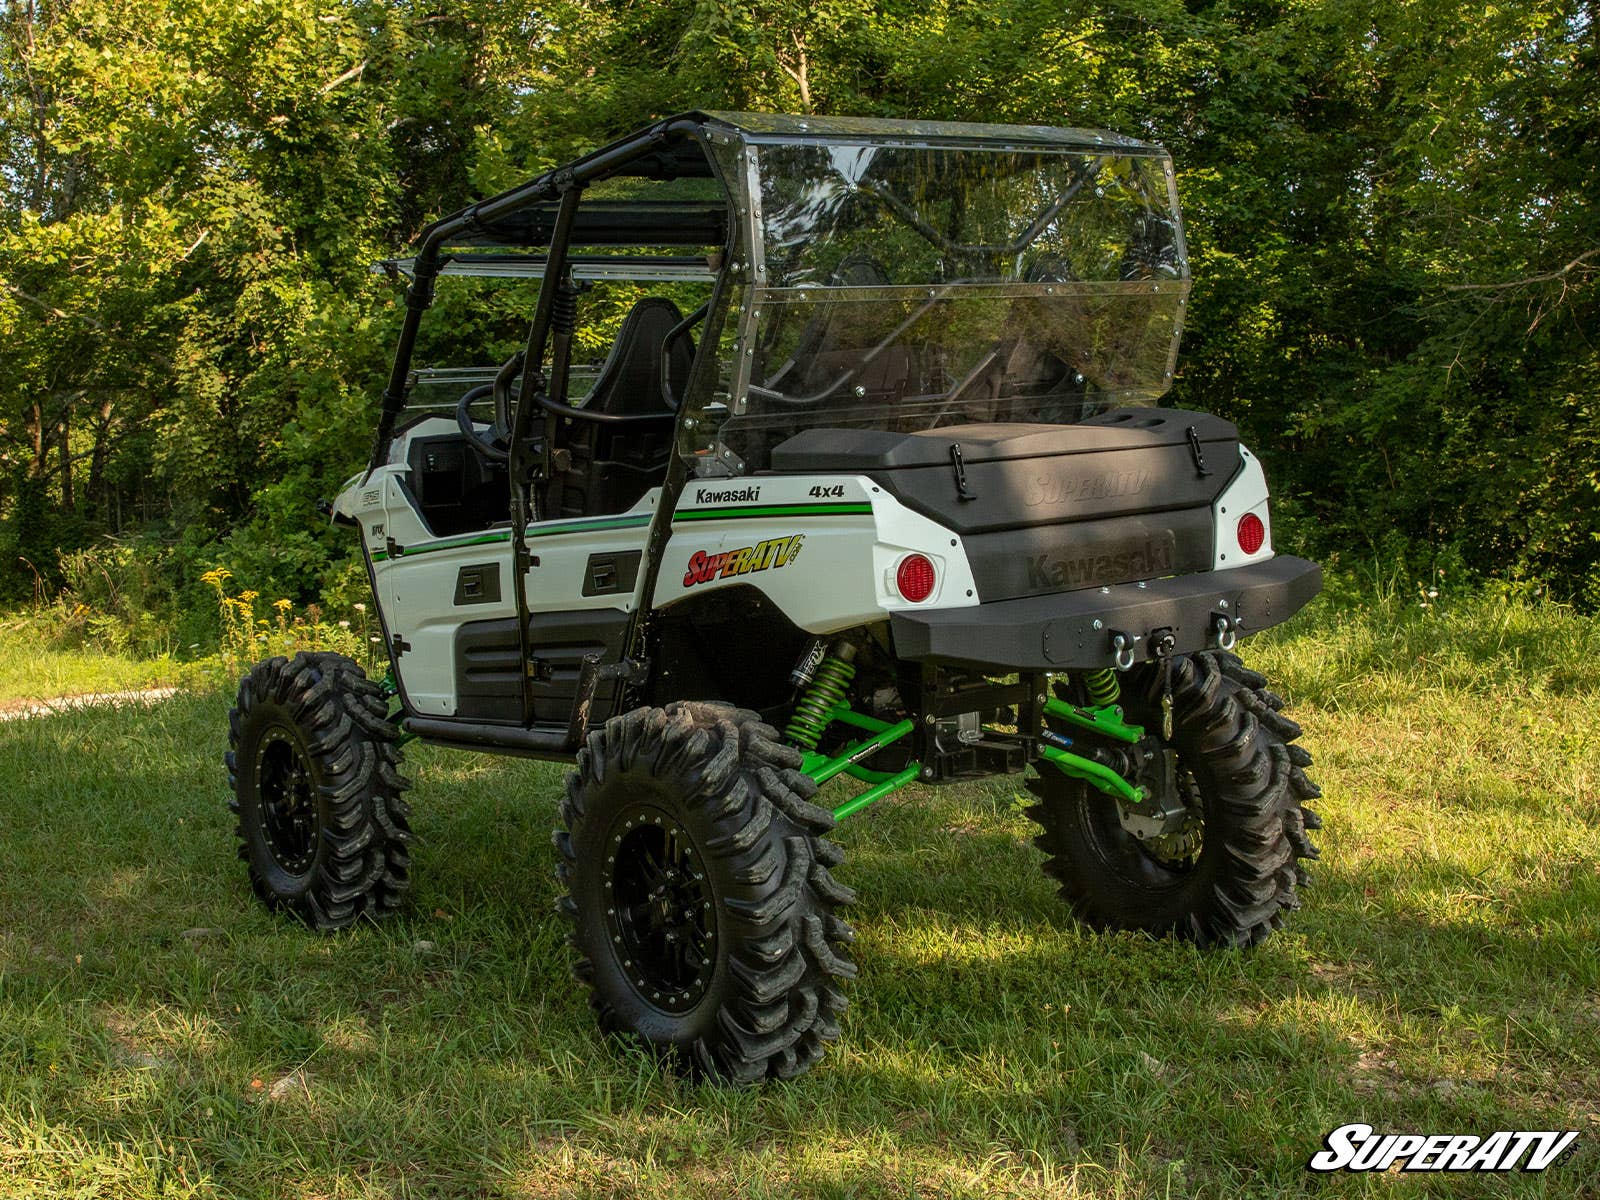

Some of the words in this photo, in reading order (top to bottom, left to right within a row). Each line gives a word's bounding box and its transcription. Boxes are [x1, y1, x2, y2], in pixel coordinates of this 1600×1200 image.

[696, 486, 761, 504] Kawasaki
[808, 485, 845, 498] 4x4
[683, 534, 801, 588] SUPERATV
[1027, 537, 1172, 589] Kawasaki
